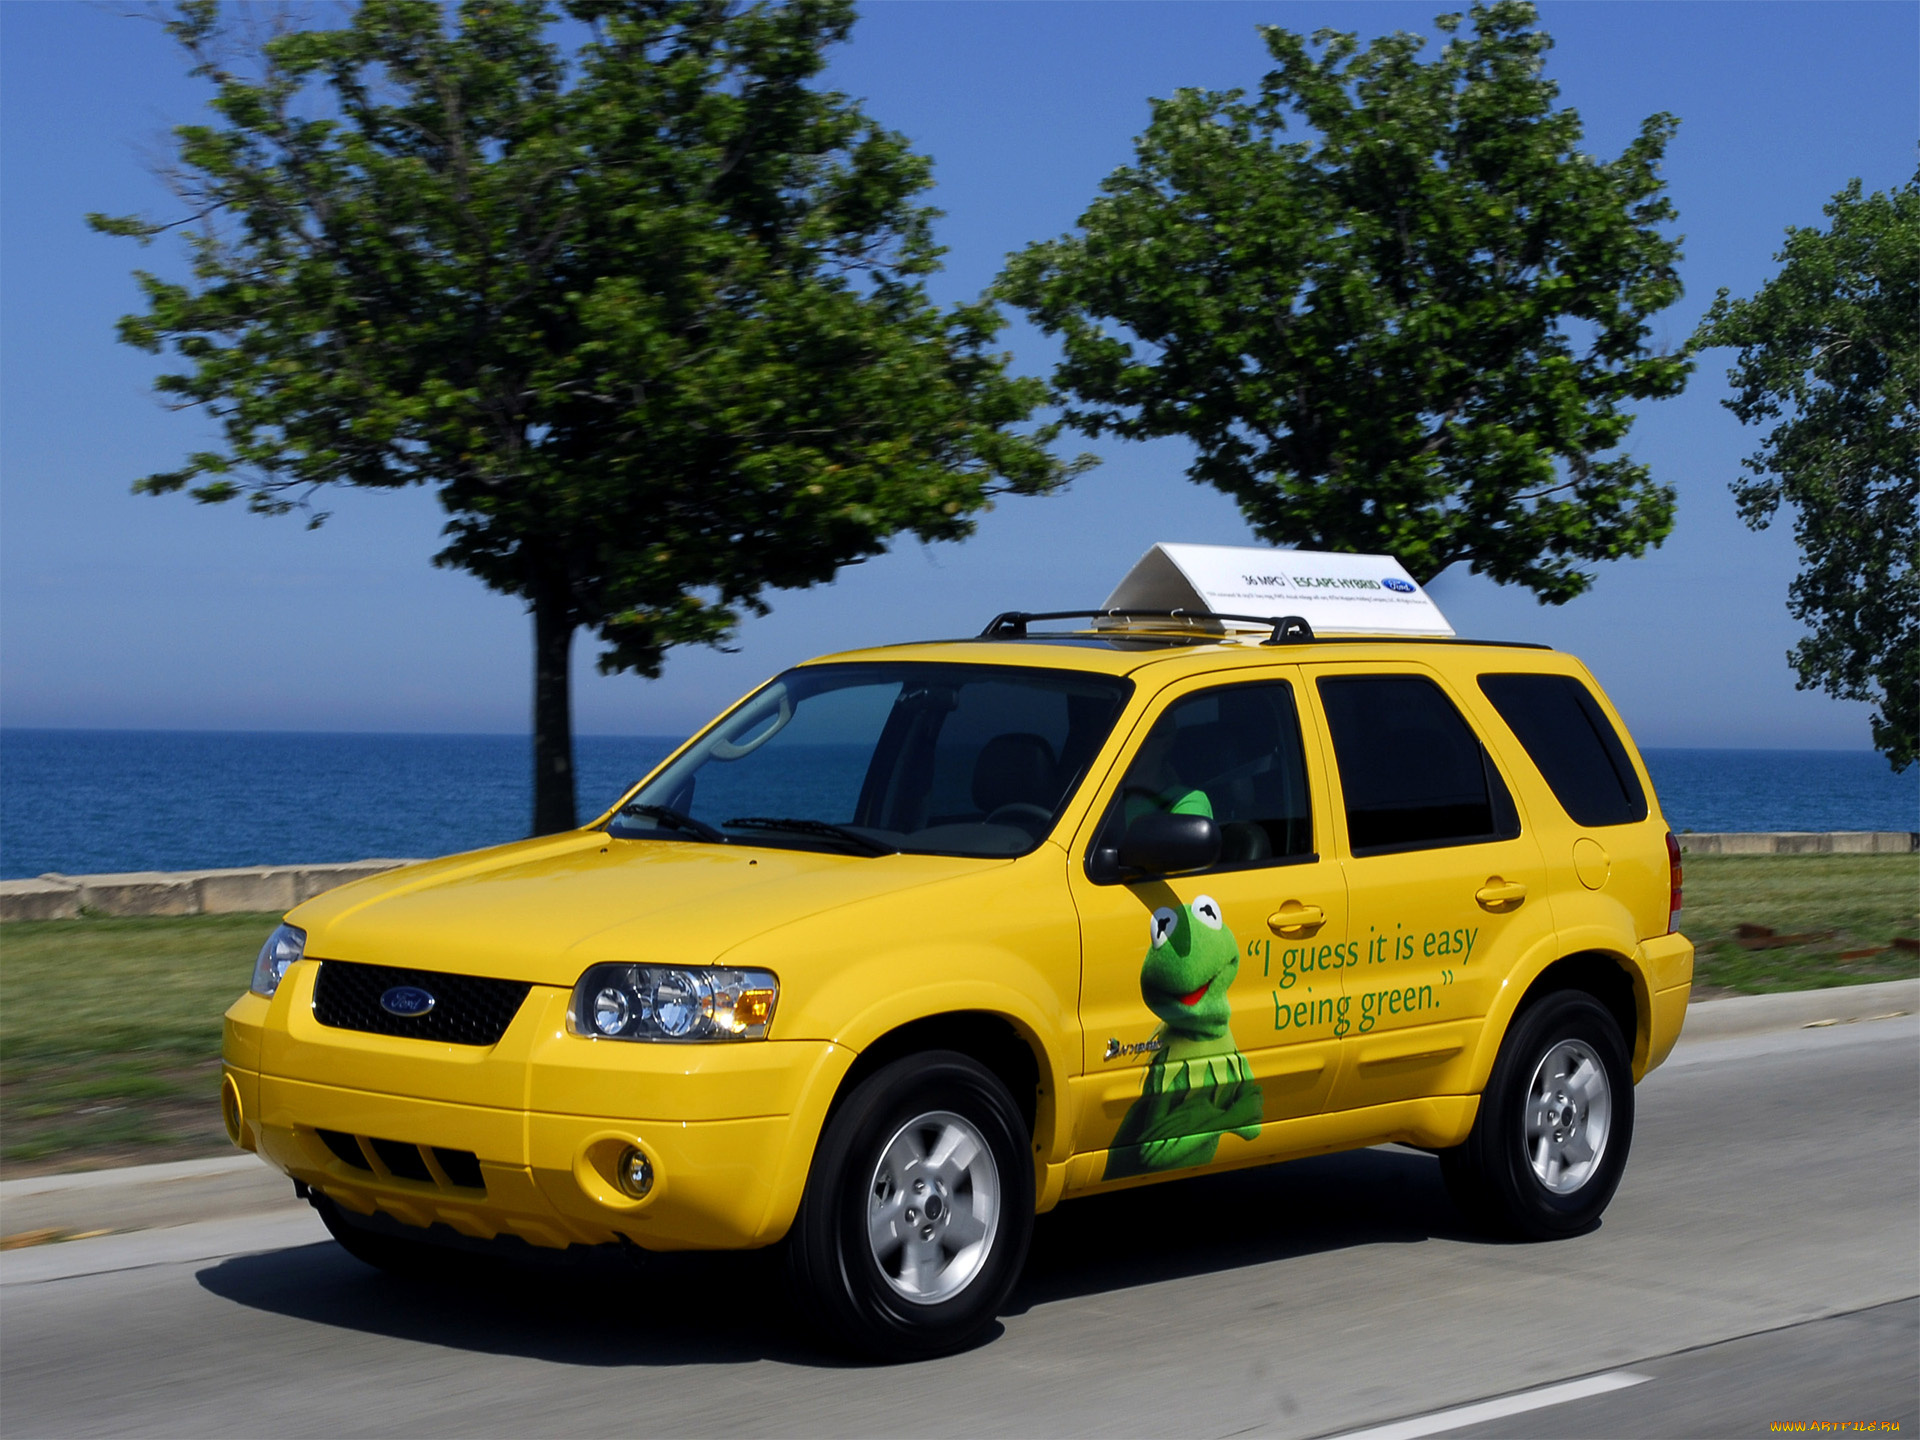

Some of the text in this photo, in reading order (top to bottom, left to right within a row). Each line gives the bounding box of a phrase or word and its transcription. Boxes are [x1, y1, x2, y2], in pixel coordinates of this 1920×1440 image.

[1293, 577, 1381, 590] ESCAPE HYBRID
[1279, 941, 1358, 989] guess
[1368, 926, 1387, 964] it
[1395, 923, 1414, 961] is
[1423, 927, 1478, 965] easy
[1272, 987, 1351, 1036] being
